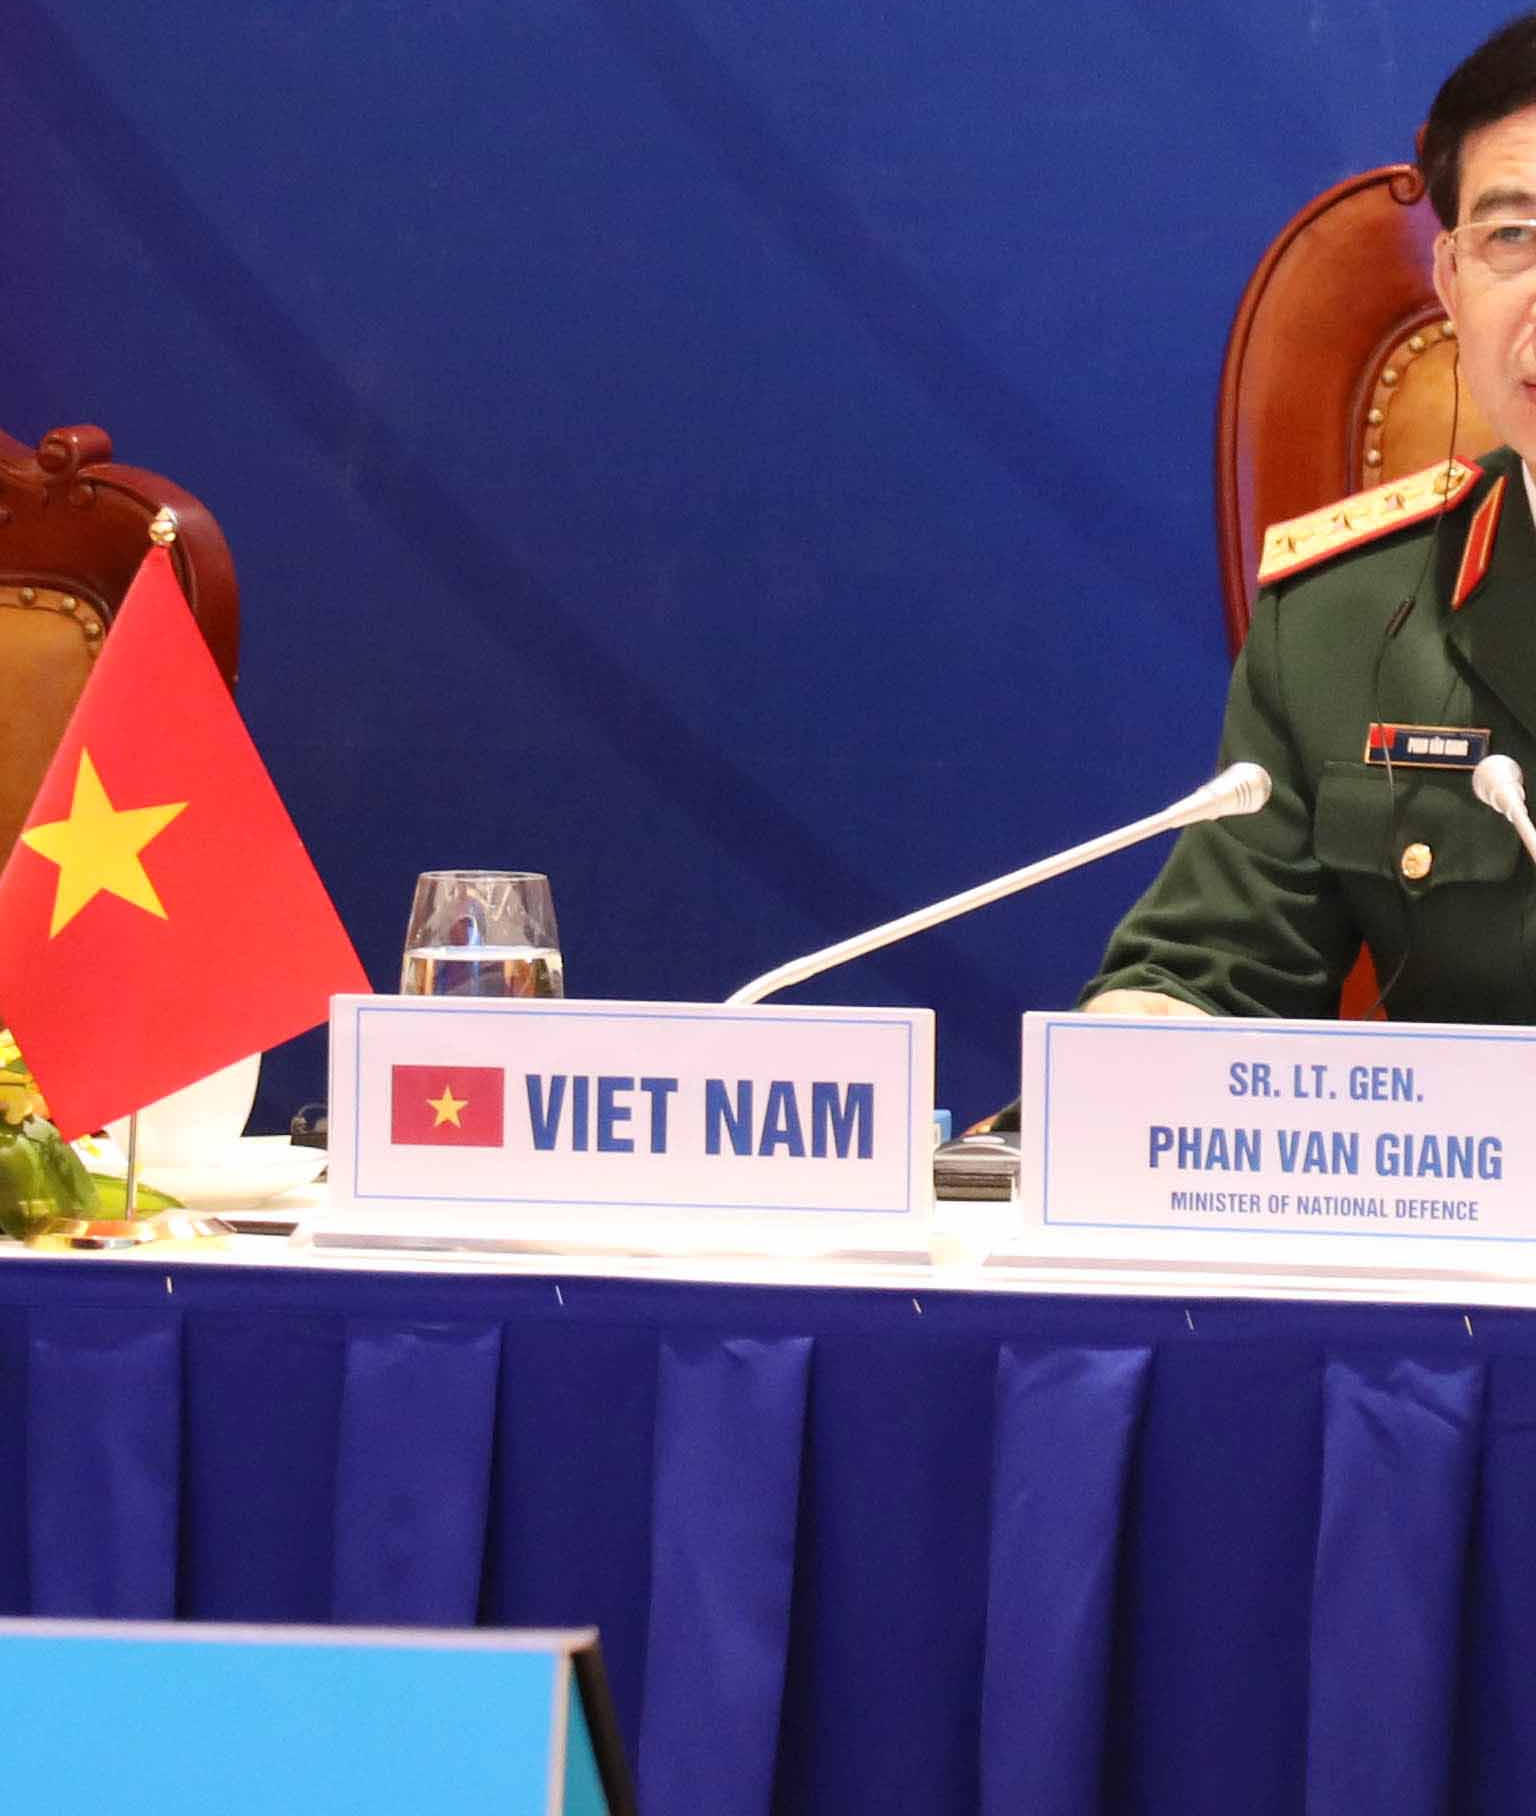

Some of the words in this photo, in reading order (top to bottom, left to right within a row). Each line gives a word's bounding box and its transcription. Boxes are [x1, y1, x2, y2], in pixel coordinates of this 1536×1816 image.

[1228, 1062, 1278, 1097] SR.
[1294, 1064, 1340, 1099] LT.
[1349, 1065, 1424, 1102] GEN.
[524, 1073, 679, 1155] VIET
[704, 1078, 875, 1160] NAM
[1148, 1125, 1261, 1172] PHAN
[1277, 1129, 1359, 1176] VAN
[1374, 1132, 1504, 1180] GIANG
[1170, 1190, 1261, 1214] MINISTER
[1267, 1194, 1290, 1215] OF
[1296, 1195, 1388, 1219] NATIONAL
[1394, 1198, 1478, 1222] DEFENCE
